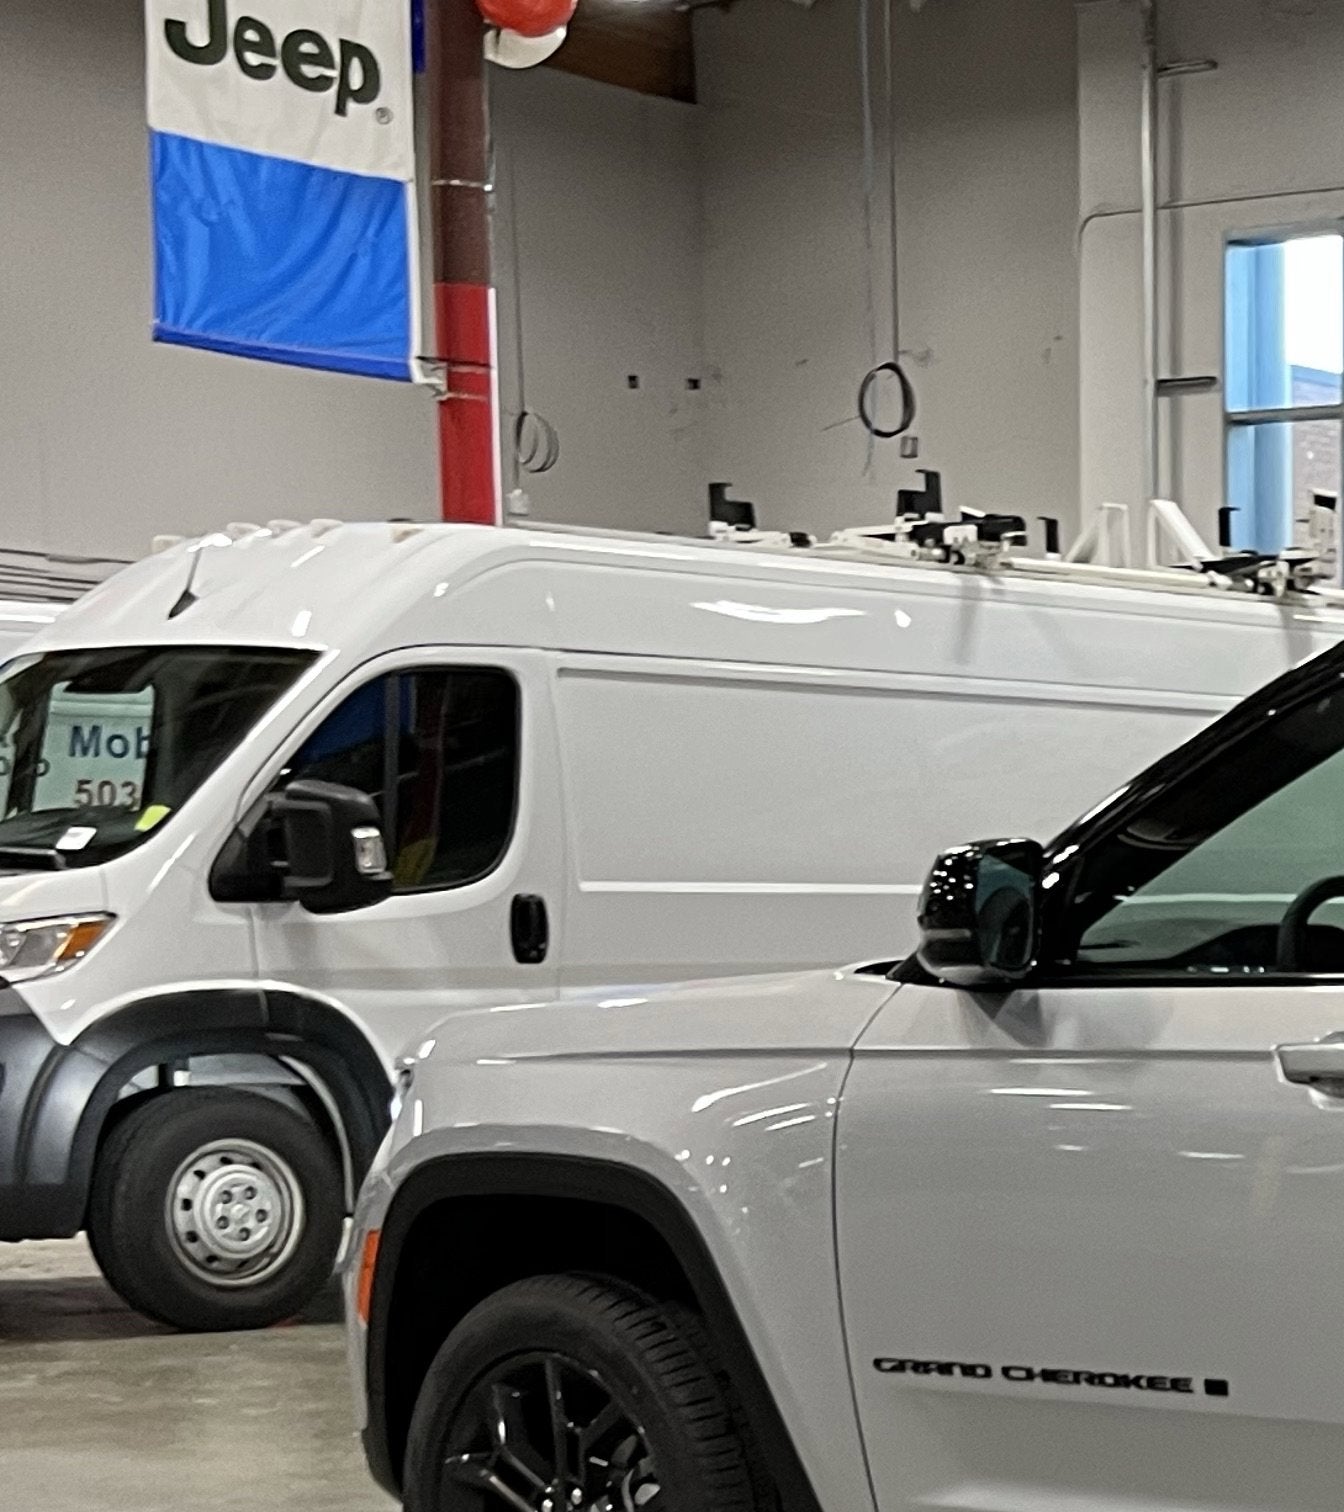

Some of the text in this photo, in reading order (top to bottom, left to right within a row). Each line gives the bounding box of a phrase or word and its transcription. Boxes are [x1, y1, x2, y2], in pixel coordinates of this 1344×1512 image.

[164, 0, 381, 118] Jeep
[74, 779, 139, 810] 503
[872, 1357, 1195, 1395] GRAND CHEROKEE
